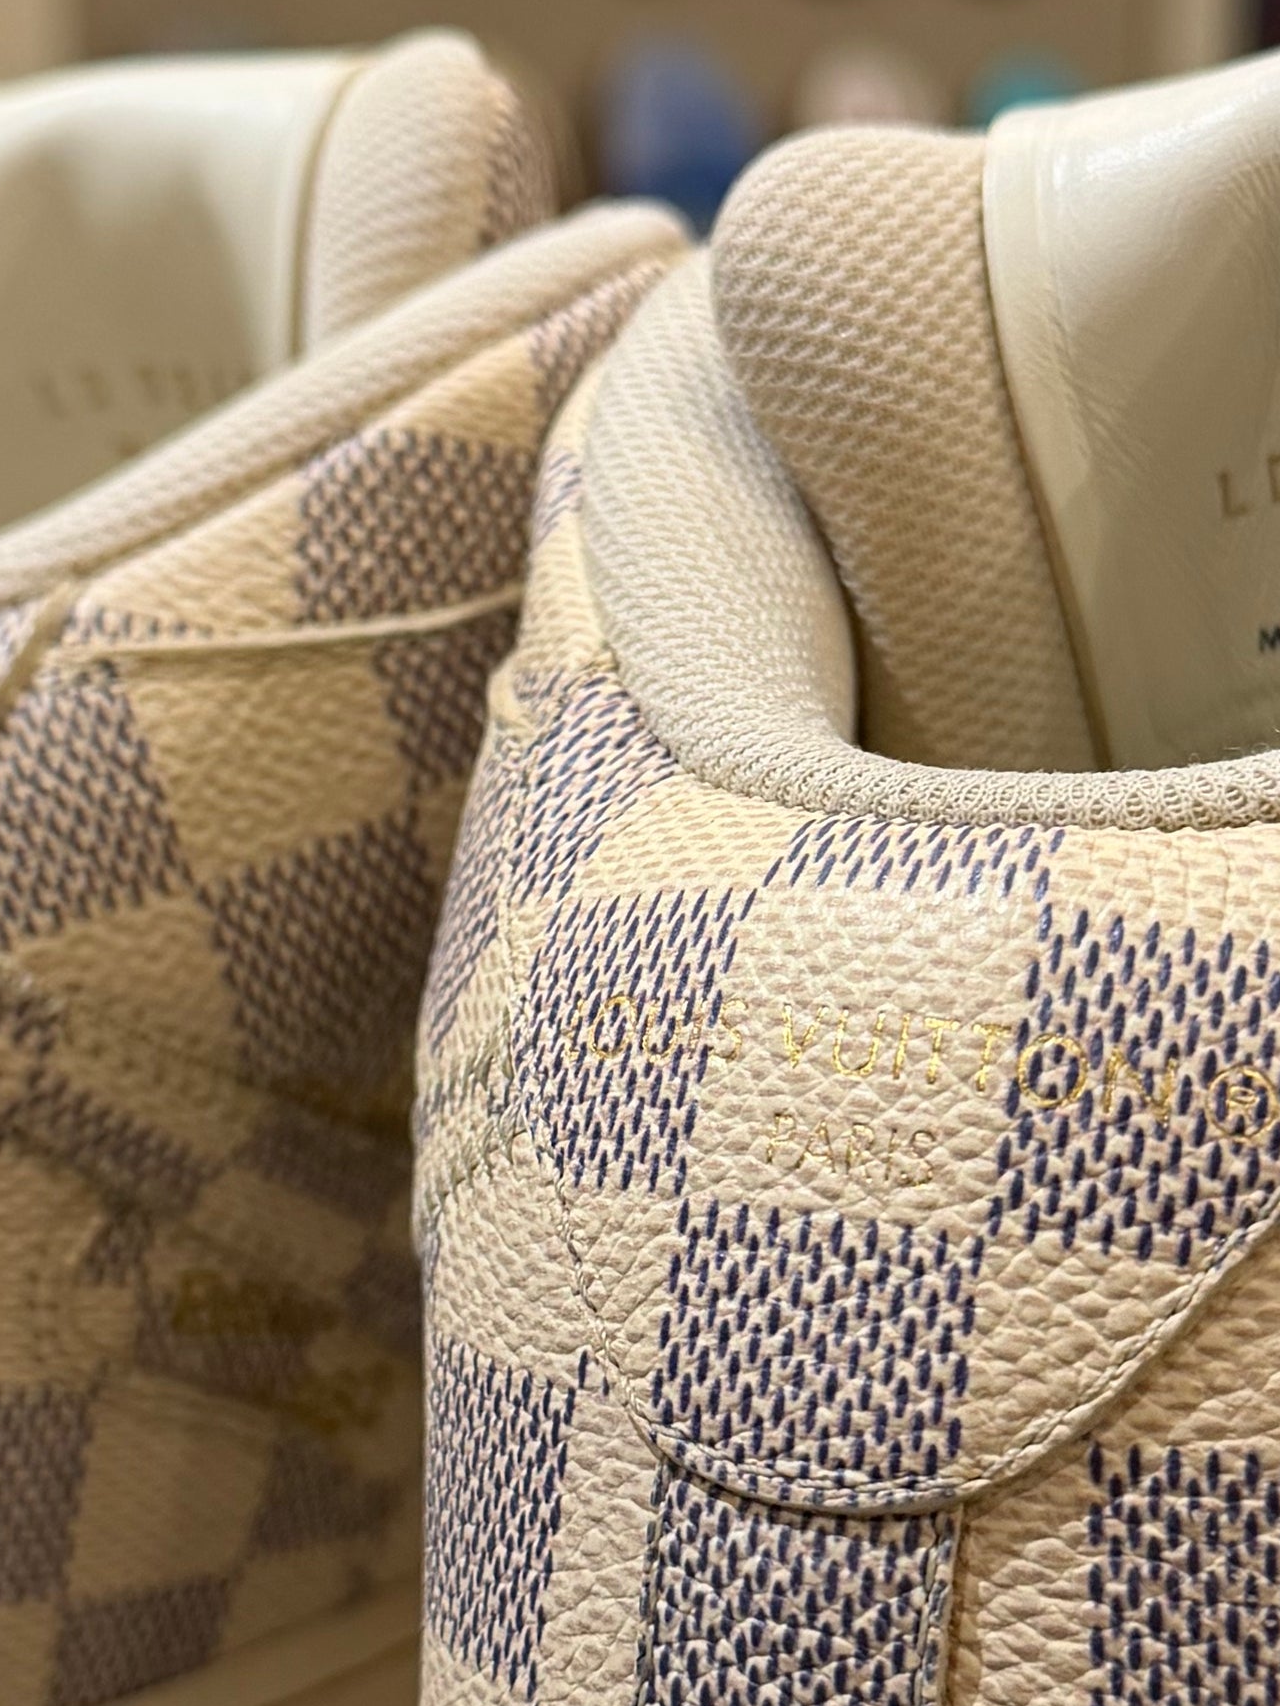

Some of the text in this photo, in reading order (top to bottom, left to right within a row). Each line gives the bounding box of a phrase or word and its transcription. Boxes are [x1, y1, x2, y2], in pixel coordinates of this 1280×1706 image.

[561, 994, 750, 1064] LOUIS
[781, 1002, 1178, 1127] VUITTON
[765, 1113, 937, 1187] PARIS
